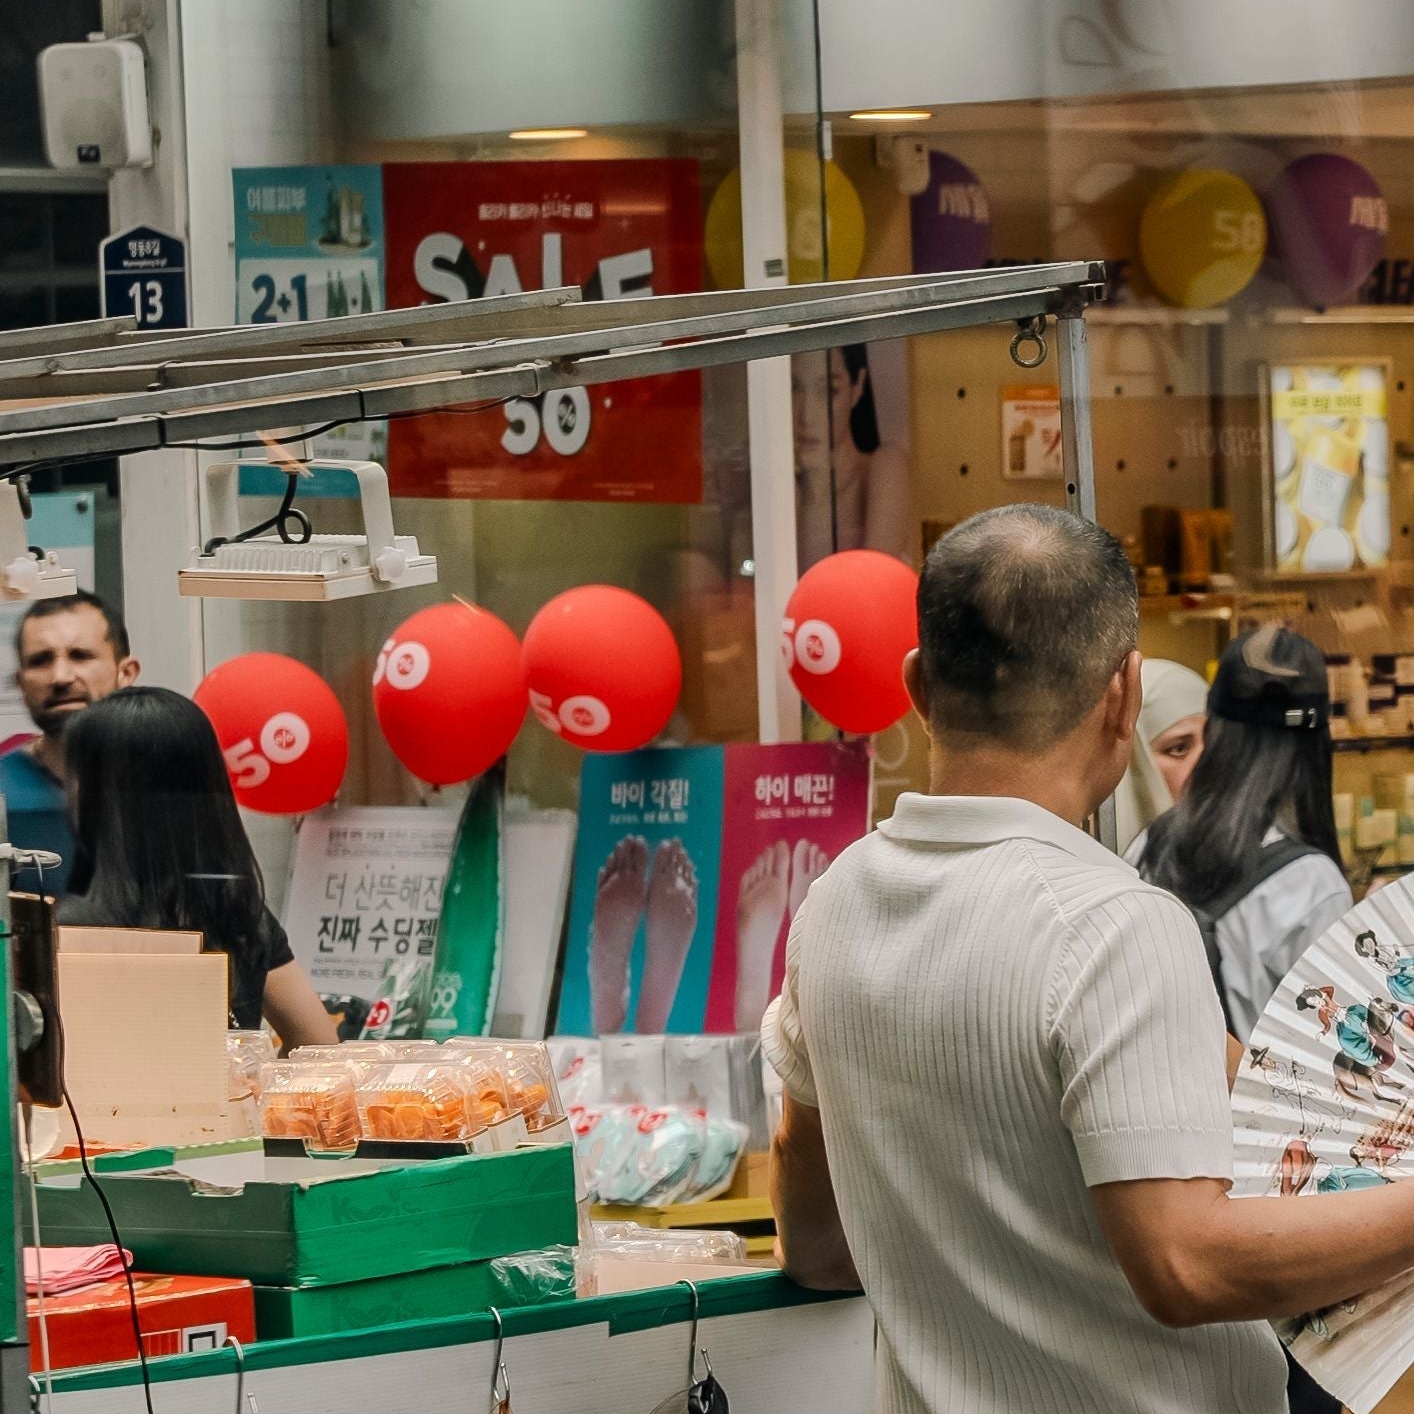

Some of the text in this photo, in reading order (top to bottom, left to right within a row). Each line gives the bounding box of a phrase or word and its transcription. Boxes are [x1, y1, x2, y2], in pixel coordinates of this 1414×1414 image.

[128, 281, 163, 323] 13
[251, 273, 308, 324] 2+1
[755, 775, 789, 805] 하이
[325, 873, 346, 909] 더
